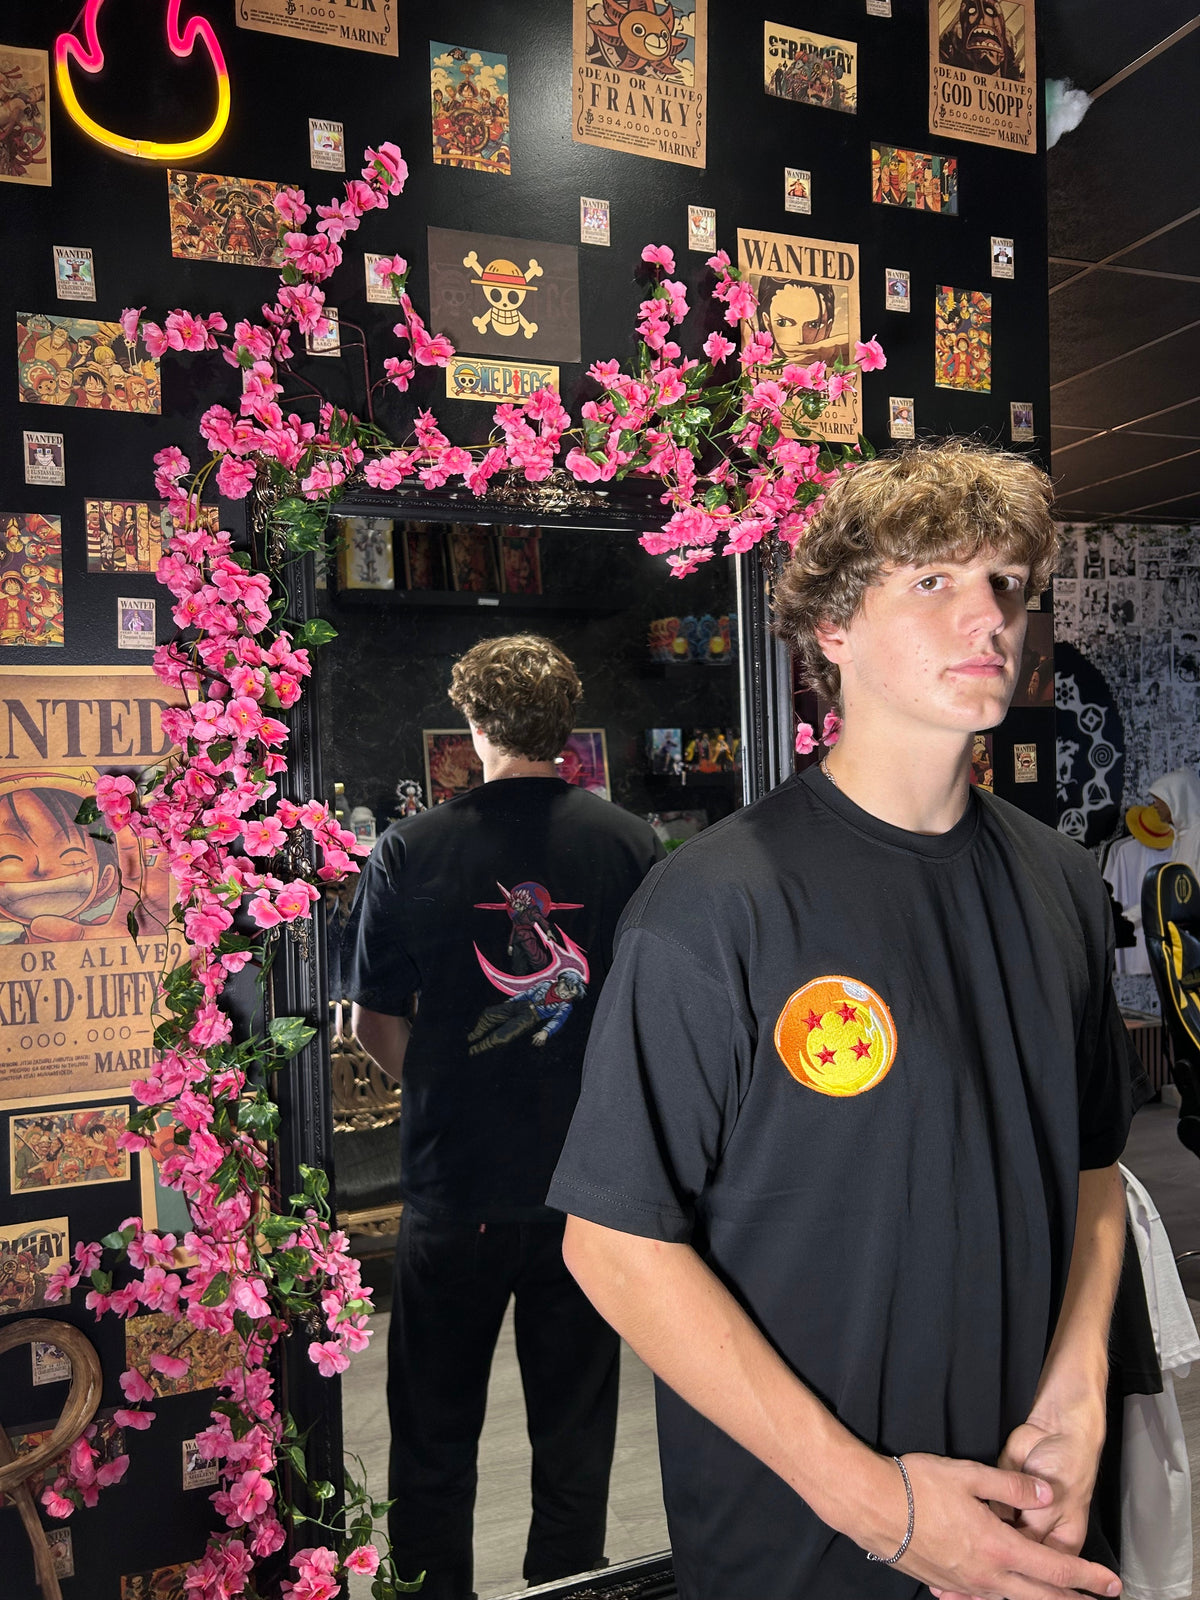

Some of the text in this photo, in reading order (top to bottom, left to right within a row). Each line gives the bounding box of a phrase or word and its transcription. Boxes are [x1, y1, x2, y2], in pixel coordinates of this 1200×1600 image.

[340, 24, 388, 47] MARINE
[585, 66, 697, 103] DEAD OR ALIVE
[938, 66, 1027, 97] DEAD OR ALIVE
[590, 82, 690, 127] FRANKY
[941, 81, 1024, 118] GOD USOPP
[310, 120, 344, 132] WANTED
[997, 128, 1030, 146] MARINE
[658, 139, 699, 160] MARINE
[786, 169, 810, 180] WANTED
[582, 198, 608, 210] WANTED
[689, 207, 715, 218] WANTED
[55, 248, 92, 259] WANTED
[742, 237, 855, 281] WANTED
[26, 433, 63, 445] WANTED
[819, 421, 856, 436] MARINE
[120, 600, 155, 610] WANTED
[0, 698, 175, 759] NTED
[21, 943, 167, 973] OR ALIVE
[94, 1047, 162, 1074] MARIN
